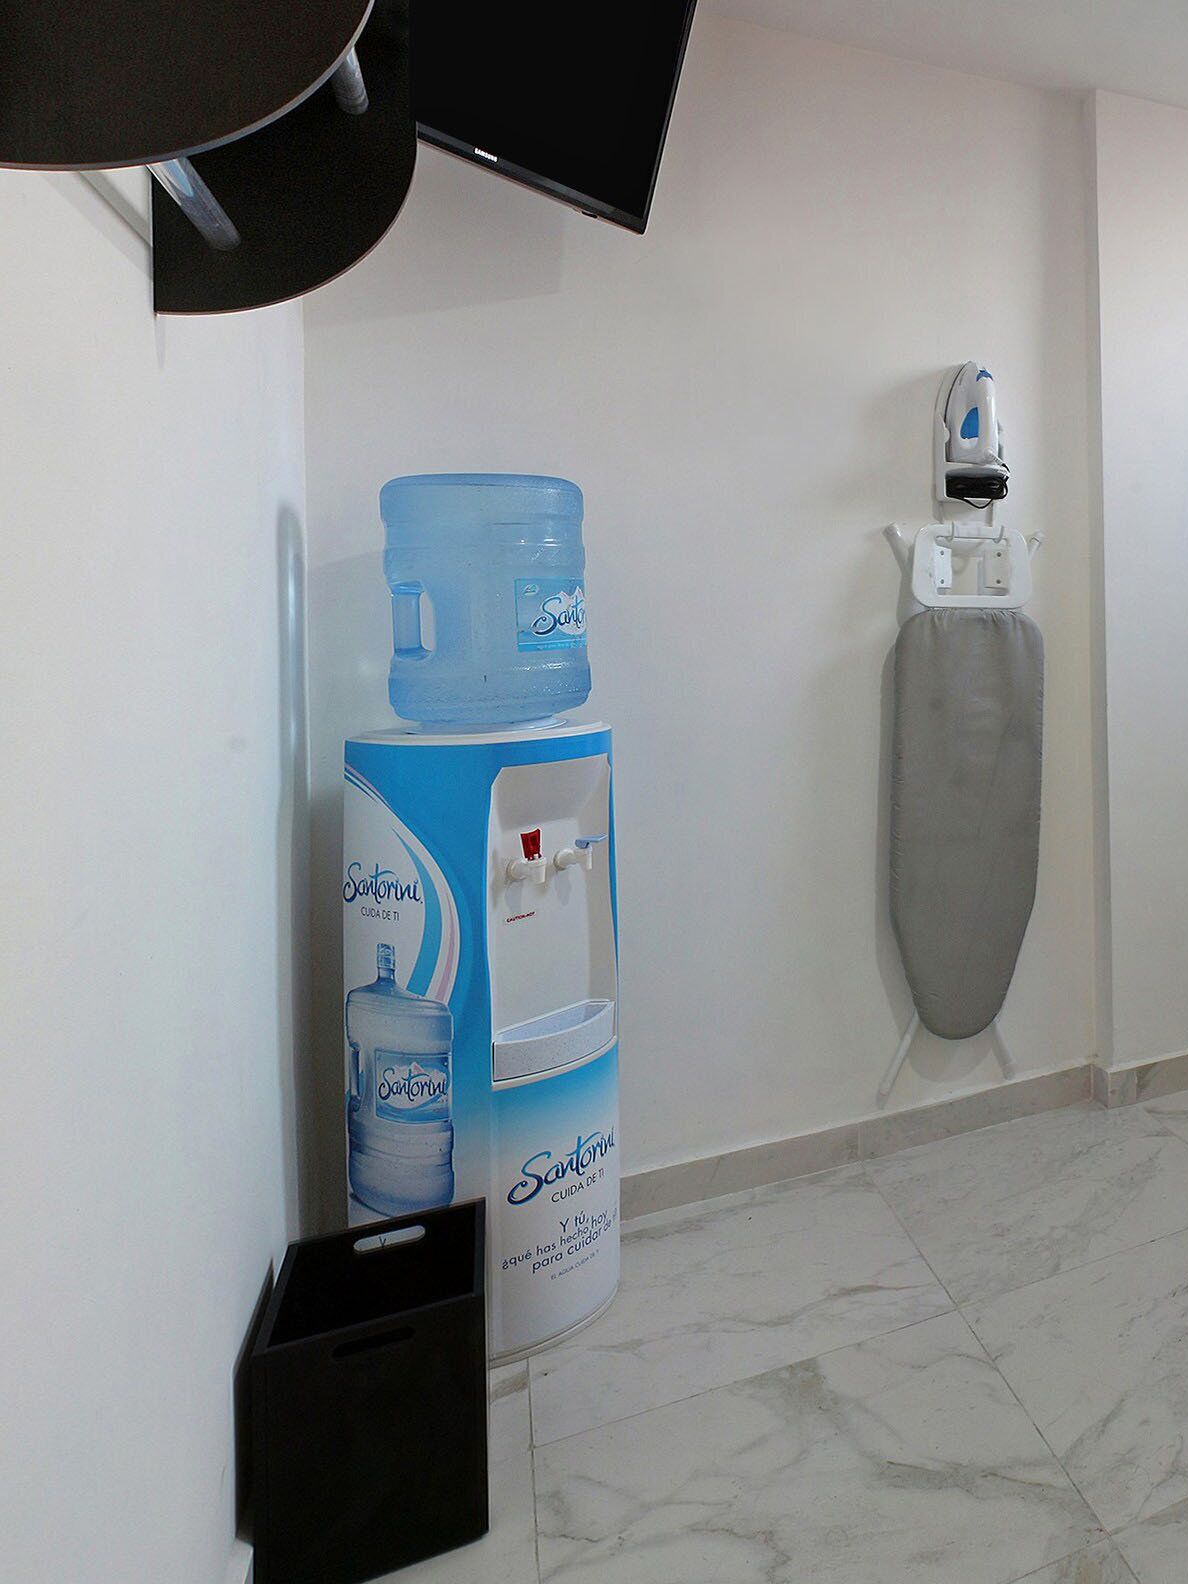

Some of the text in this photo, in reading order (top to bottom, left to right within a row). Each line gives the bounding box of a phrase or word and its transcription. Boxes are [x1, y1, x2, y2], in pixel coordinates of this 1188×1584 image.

[343, 862, 421, 904] Santorini
[382, 909, 391, 921] DE
[393, 911, 400, 921] TI
[379, 1067, 448, 1102] Santorini
[507, 1125, 615, 1206] Santorini
[551, 1182, 584, 1203] CUIDA
[586, 1172, 597, 1187] DE
[502, 1249, 532, 1270] ¿qué
[536, 1242, 556, 1256] has
[560, 1225, 589, 1246] hecho
[591, 1210, 608, 1229] hoy
[560, 1217, 569, 1233] Y
[532, 1252, 563, 1274] para
[567, 1227, 602, 1255] cuidar
